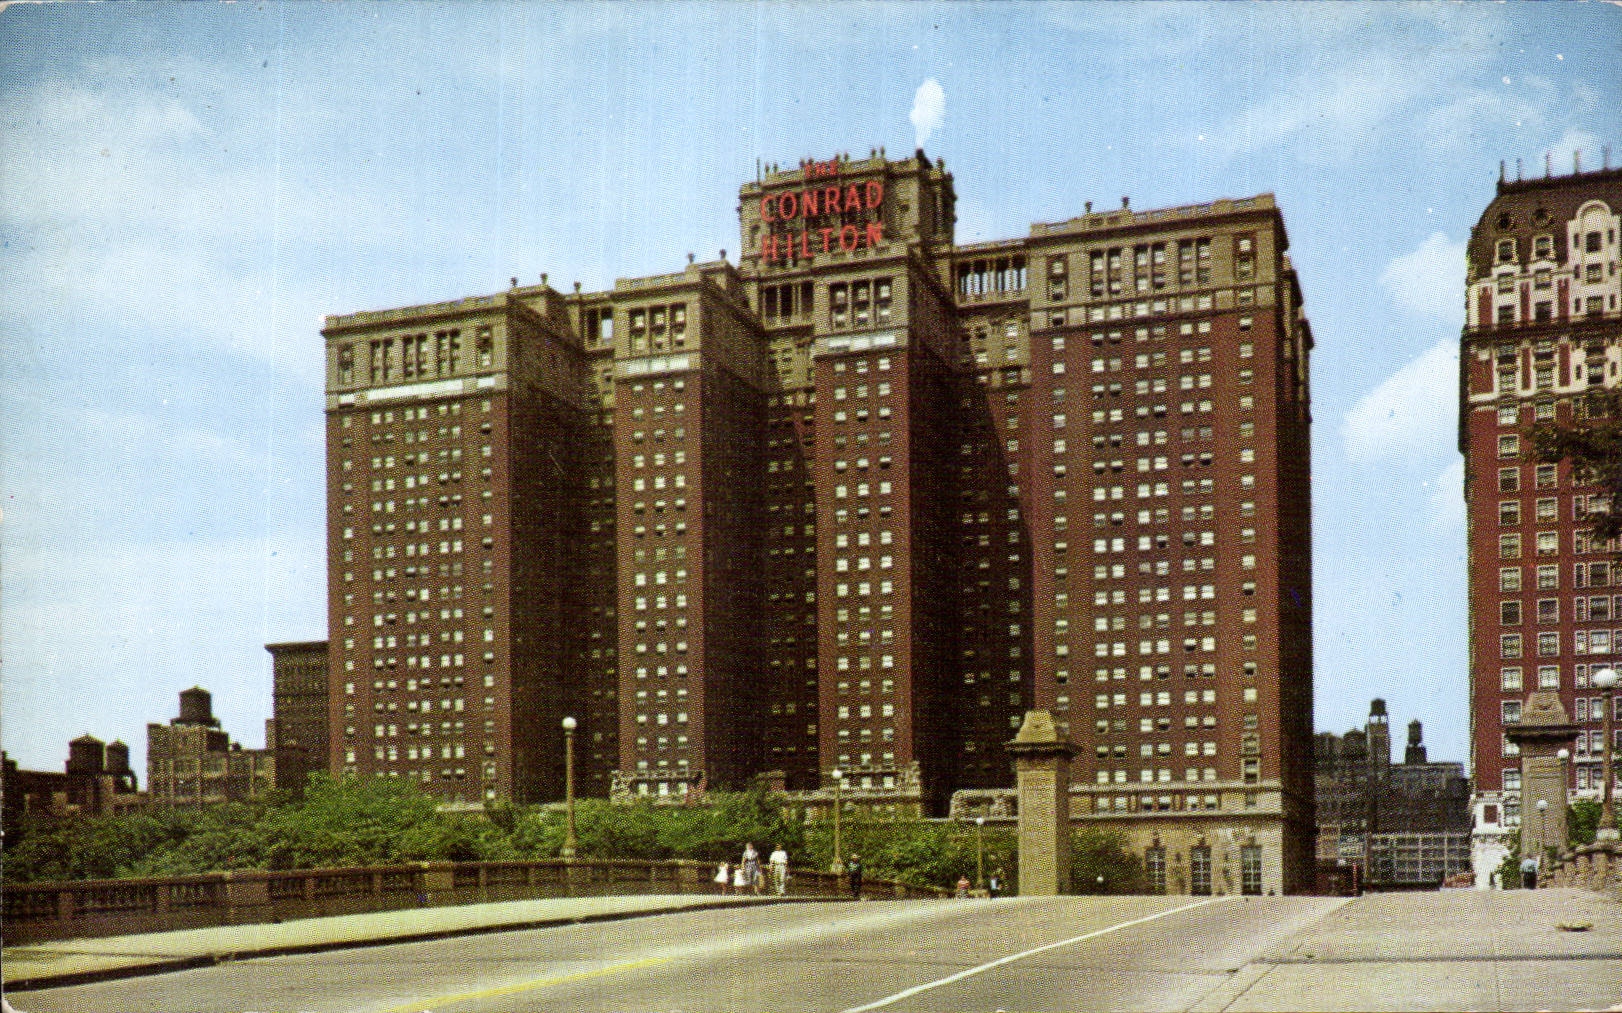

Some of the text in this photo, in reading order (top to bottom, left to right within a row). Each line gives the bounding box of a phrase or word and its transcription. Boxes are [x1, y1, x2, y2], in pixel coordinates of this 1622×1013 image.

[804, 160, 839, 178] THE
[760, 180, 884, 222] CONRAD
[761, 221, 883, 263] HILTON
